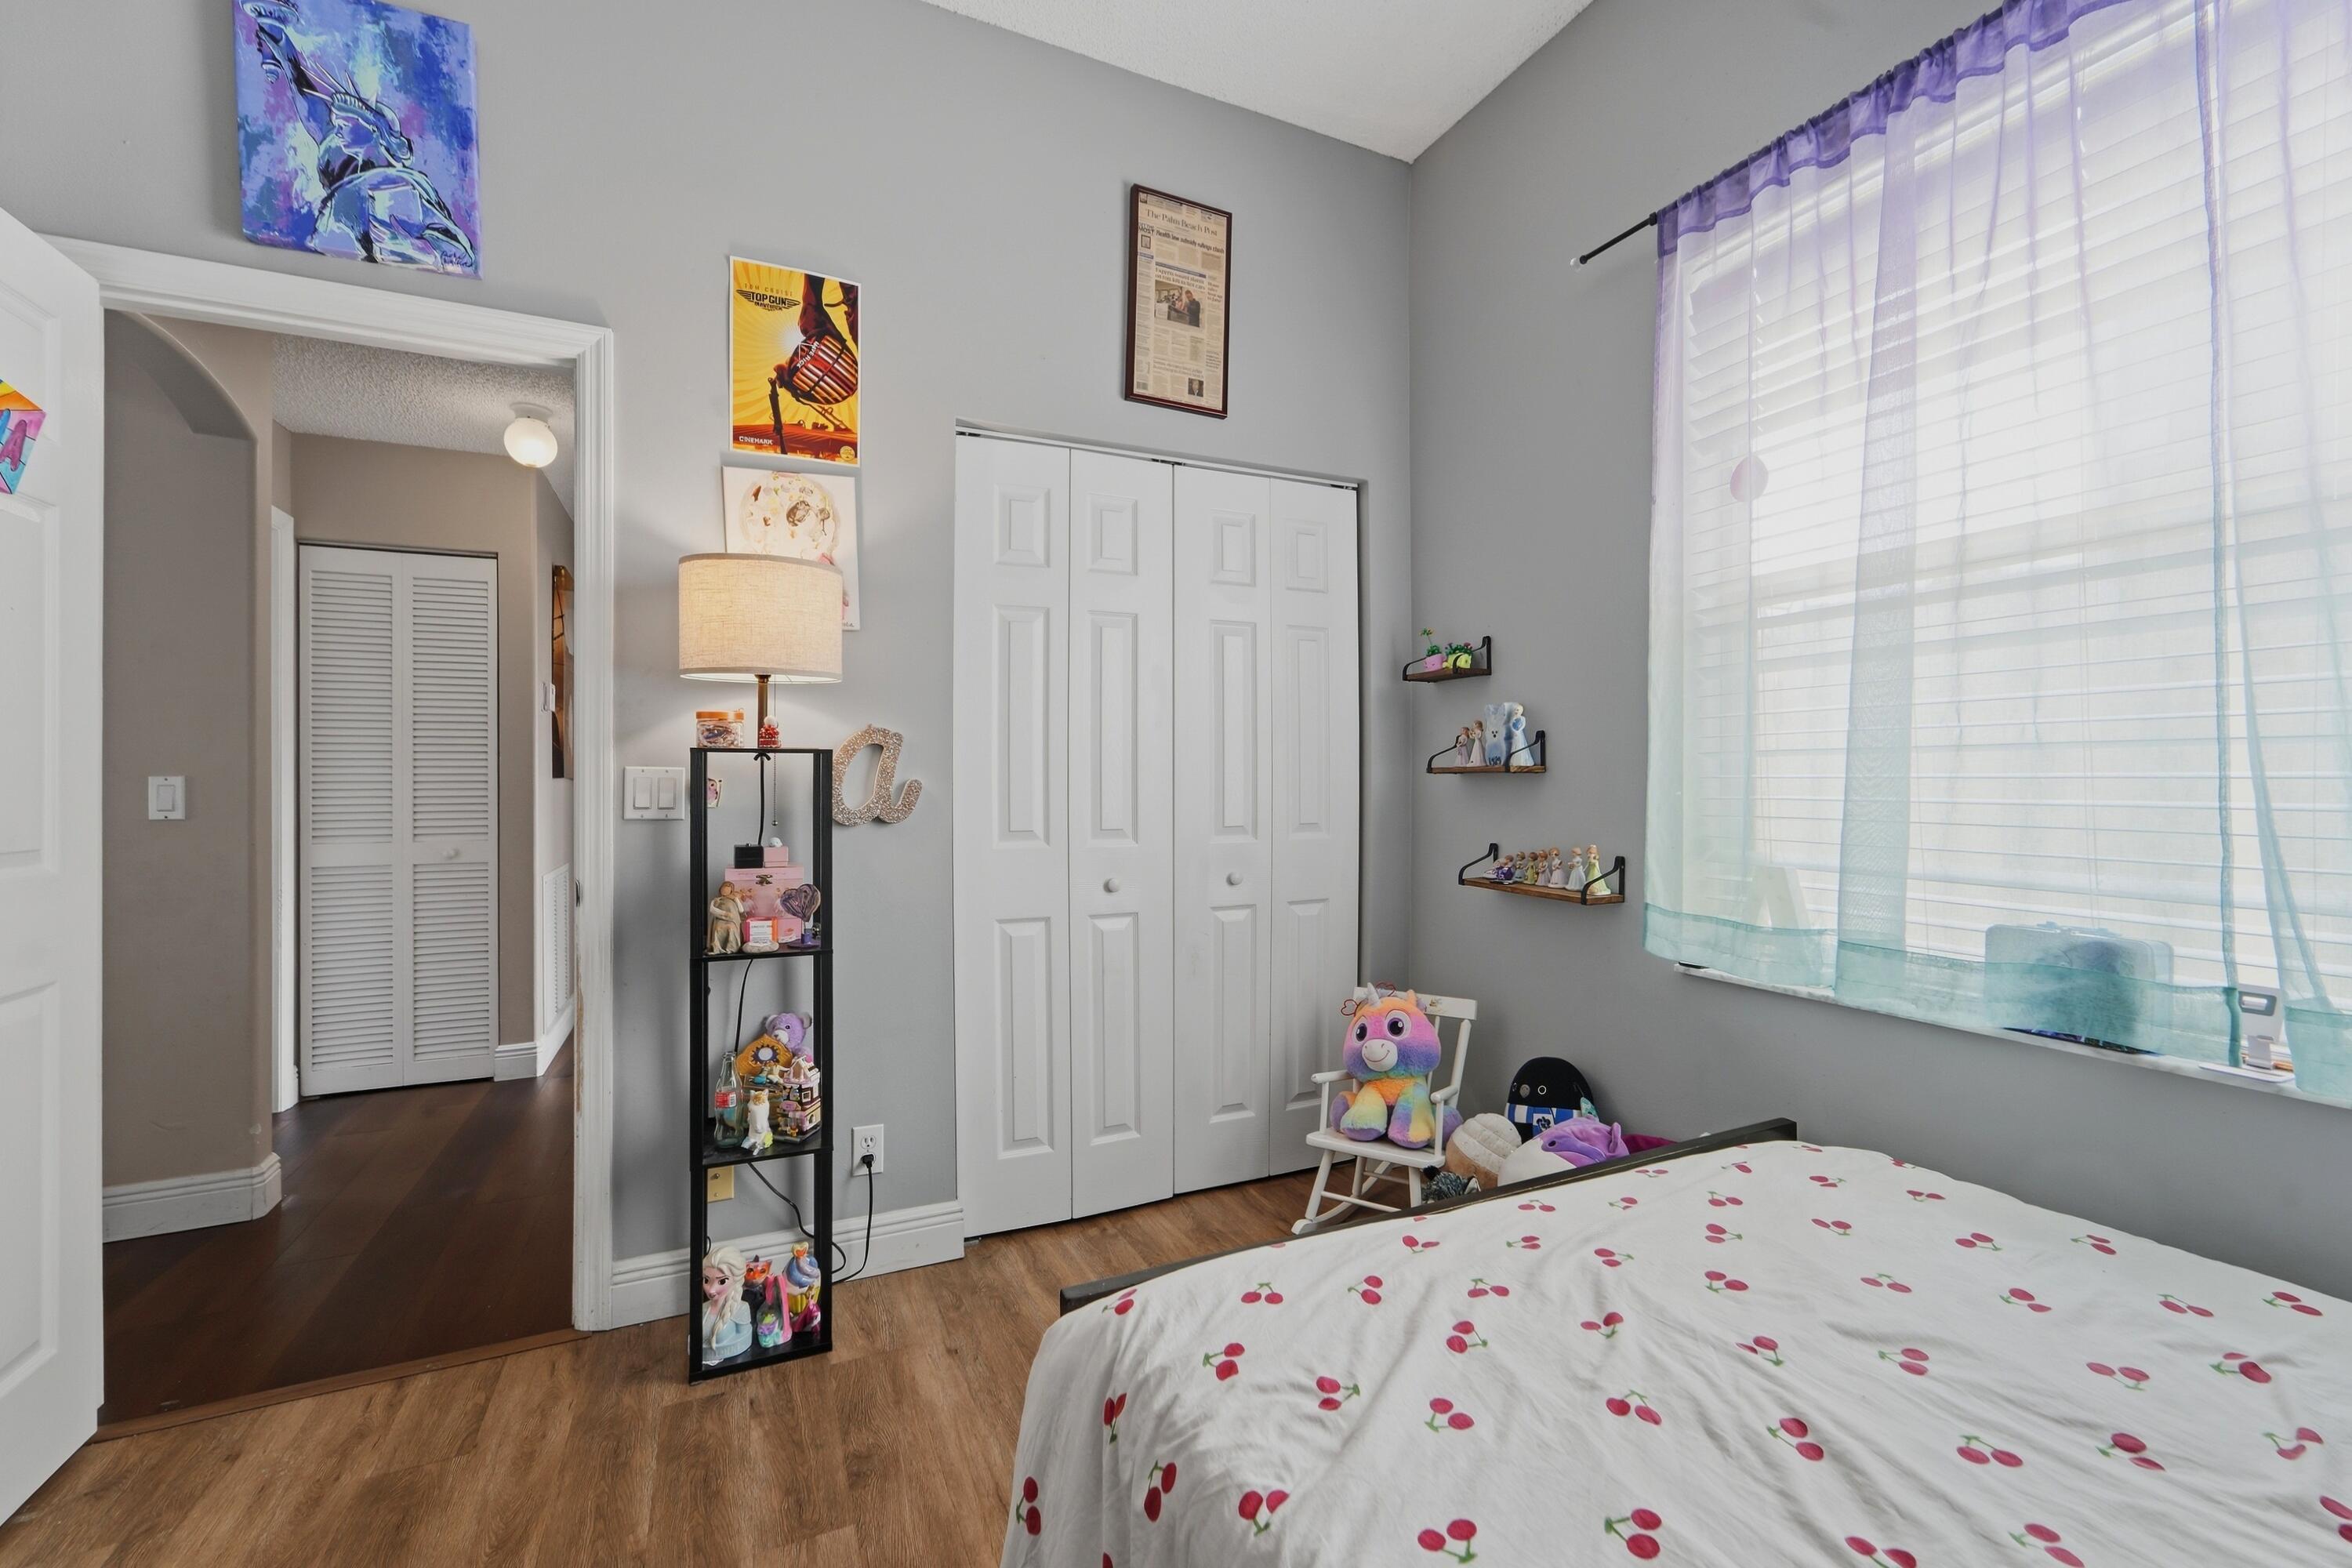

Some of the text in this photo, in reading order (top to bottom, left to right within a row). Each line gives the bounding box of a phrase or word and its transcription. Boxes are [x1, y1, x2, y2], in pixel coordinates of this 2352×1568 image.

[1145, 209, 1160, 220] The
[1162, 213, 1180, 226] Palm
[1181, 220, 1203, 233] Beach
[1204, 226, 1218, 236] Post
[764, 287, 793, 297] CRUISE
[750, 292, 787, 307] TOP GUN
[739, 436, 773, 445] CINEMARK
